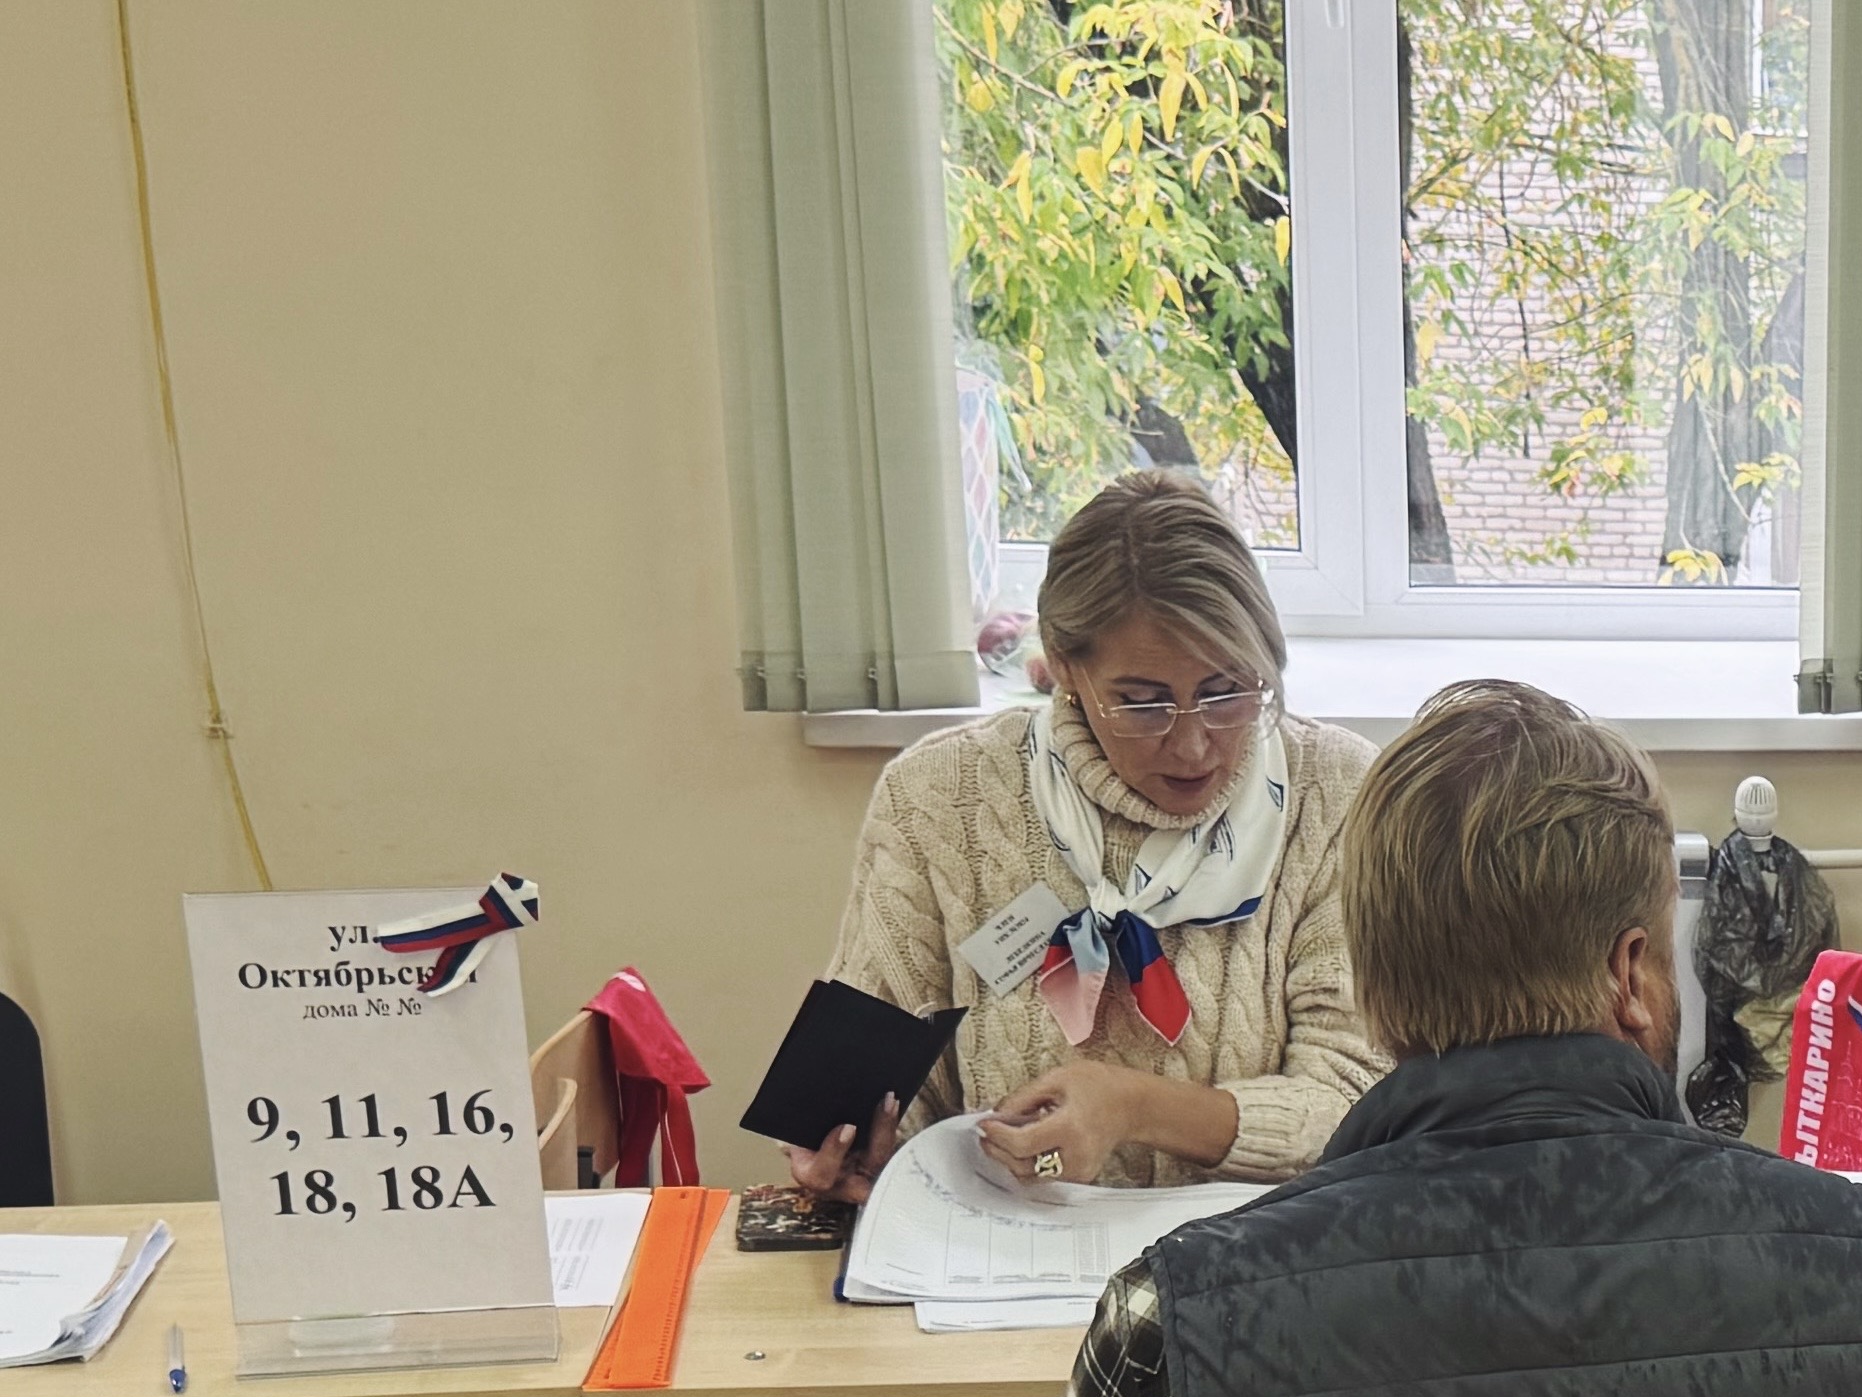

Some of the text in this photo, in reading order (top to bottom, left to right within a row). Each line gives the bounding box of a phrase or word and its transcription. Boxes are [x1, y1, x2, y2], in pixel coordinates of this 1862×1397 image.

[327, 925, 380, 952] ул.
[237, 959, 478, 994] Октябрьск
[302, 997, 422, 1020] дома № №
[1794, 978, 1837, 1168] ЫТКАРИНО
[246, 1088, 514, 1152] 9, 11, 16,
[269, 1164, 497, 1224] 18, 18А
